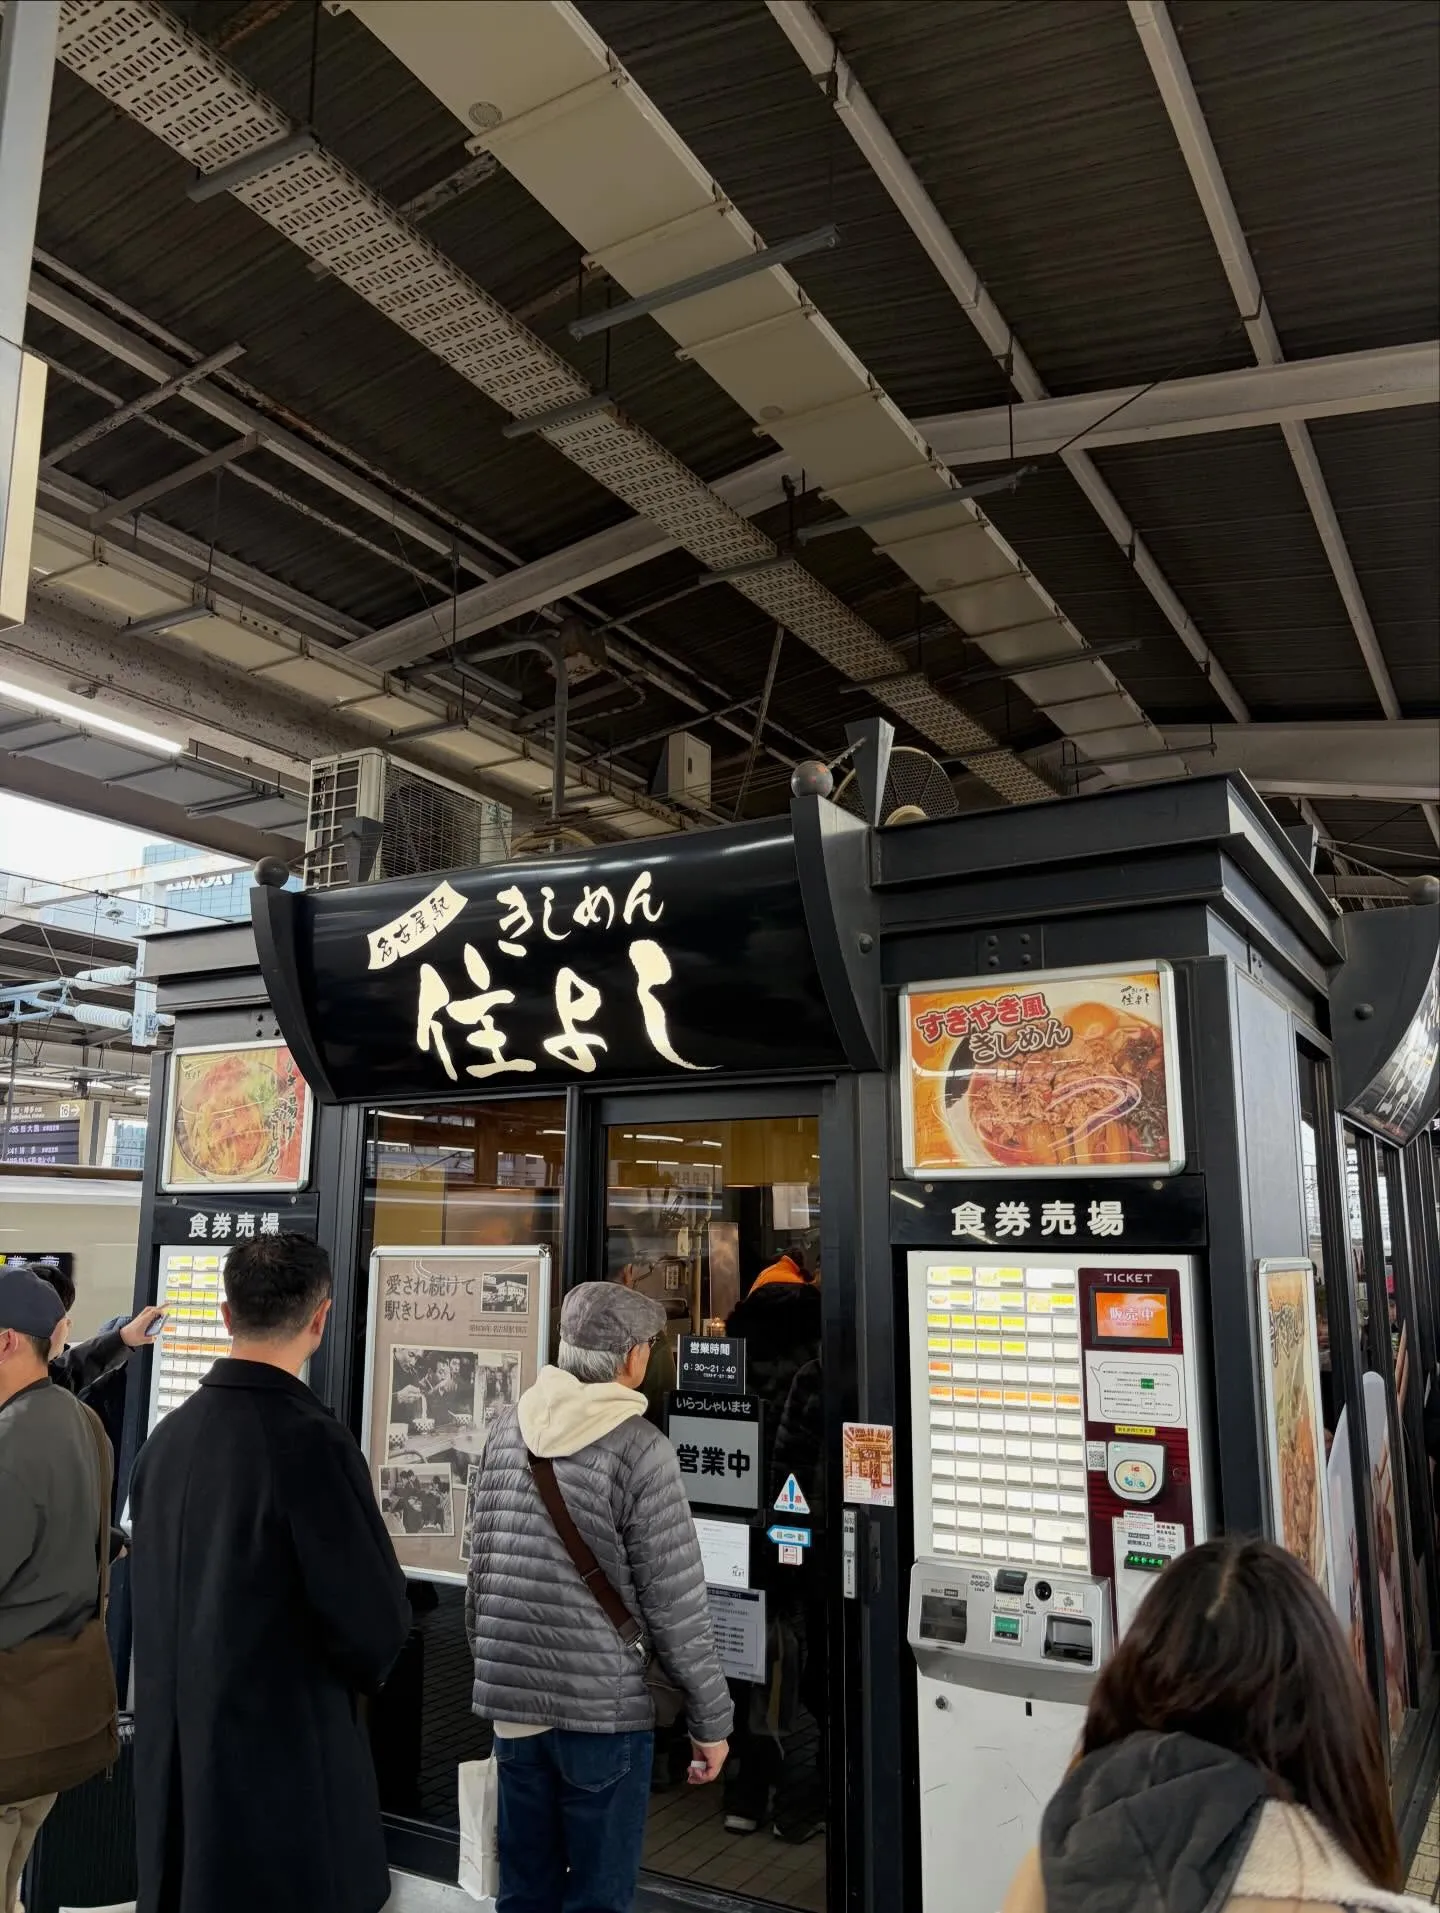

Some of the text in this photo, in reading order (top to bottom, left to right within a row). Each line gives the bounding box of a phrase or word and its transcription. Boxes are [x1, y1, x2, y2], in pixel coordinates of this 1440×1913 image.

[376, 896, 449, 963] 名古屋駅
[497, 871, 664, 957] きしめん
[416, 939, 724, 1081] 住よし
[918, 993, 1048, 1042] すきやき風
[969, 1020, 1073, 1063] きしめん
[188, 1212, 281, 1239] 食券売場
[951, 1201, 1125, 1236] 食券売場
[384, 1274, 477, 1298] 愛され続けて
[1103, 1273, 1153, 1283] TICKET
[384, 1300, 456, 1322] 駅きしめん
[1109, 1306, 1154, 1321] 販売中
[690, 1341, 731, 1356] 営業時間
[676, 1396, 752, 1414] いらっしゃいませ
[676, 1443, 750, 1478] 営業中
